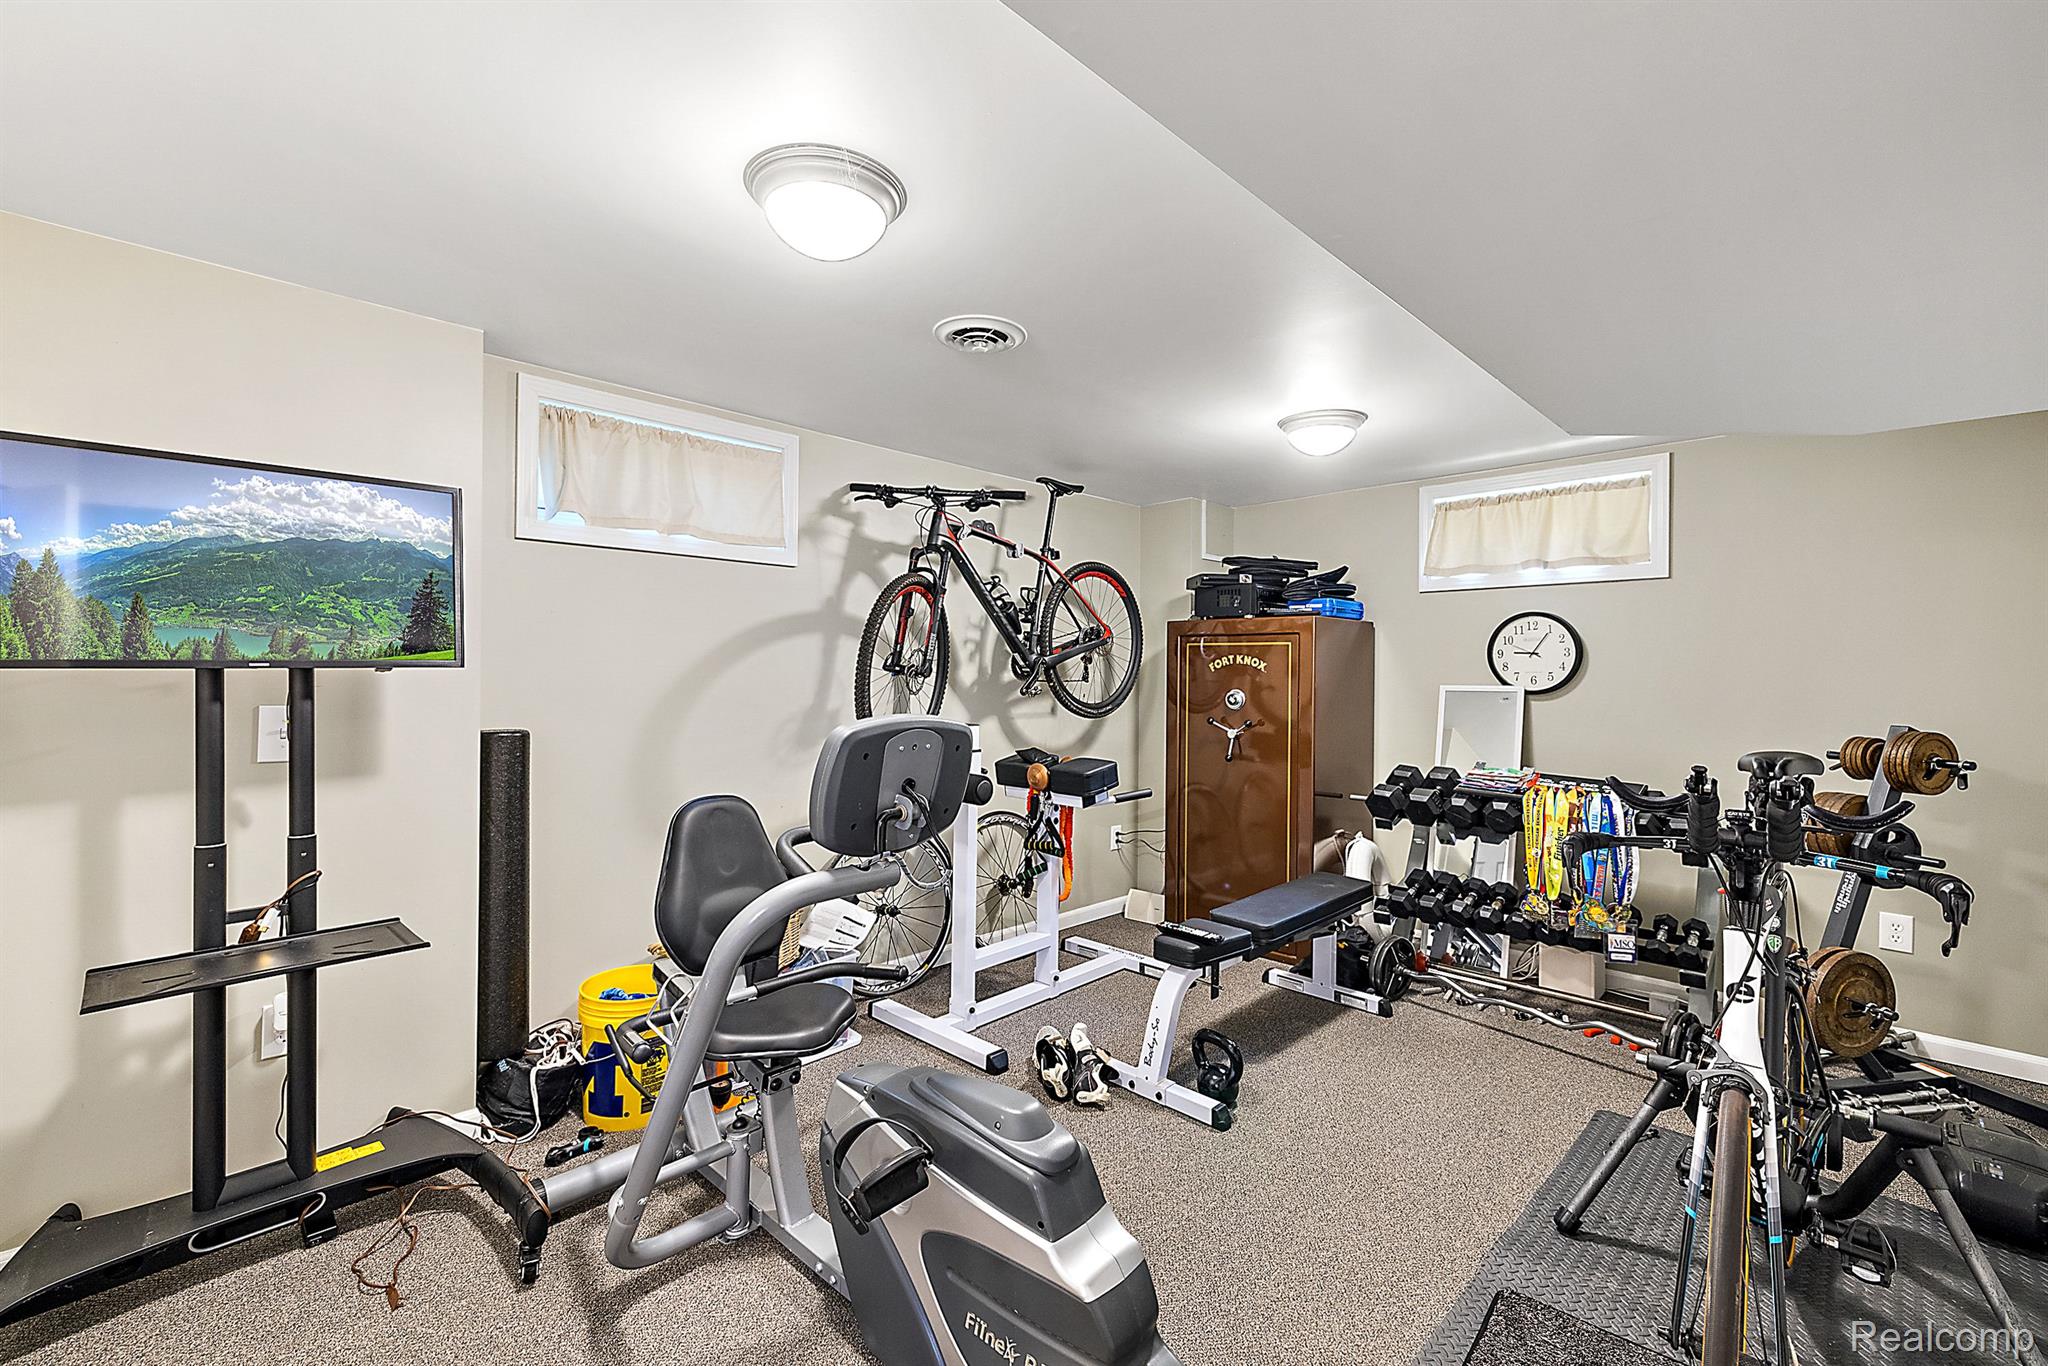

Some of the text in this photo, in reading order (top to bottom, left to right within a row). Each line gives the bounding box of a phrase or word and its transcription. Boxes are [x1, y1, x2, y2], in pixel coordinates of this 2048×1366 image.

[1527, 620, 1539, 631] 12
[1514, 626, 1524, 635] 11
[1503, 636, 1514, 645] 10
[1559, 634, 1565, 643] 2
[1497, 649, 1504, 658] 9
[1564, 648, 1571, 657] 3
[1208, 655, 1267, 672] FORT KNOX
[1502, 662, 1509, 671] 8
[1559, 662, 1566, 671] 4
[1514, 672, 1520, 681] 7
[1530, 676, 1537, 685] 6
[1548, 672, 1554, 681] 5
[1554, 827, 1565, 861] Finisher
[1662, 838, 1677, 849] 3T
